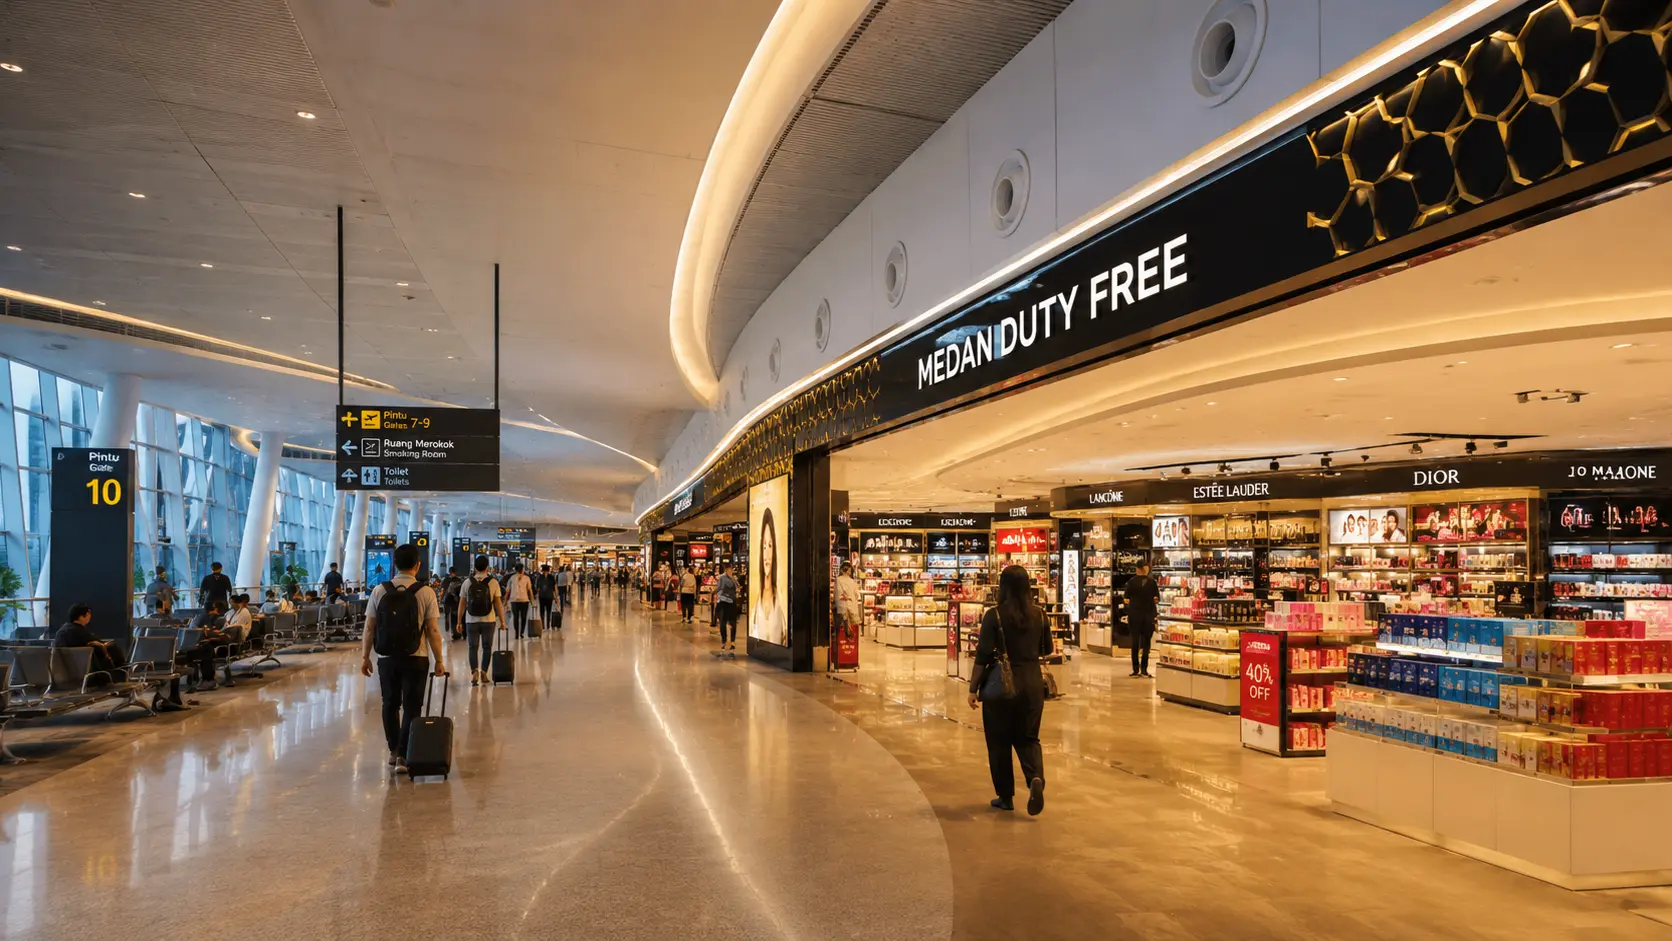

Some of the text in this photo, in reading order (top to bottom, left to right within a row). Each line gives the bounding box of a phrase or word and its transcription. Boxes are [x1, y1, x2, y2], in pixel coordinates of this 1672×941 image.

[918, 233, 1188, 390] MEDAN DUTY FREE
[383, 410, 407, 420] Pintu
[410, 417, 431, 429] 7-9
[383, 438, 455, 450] Ruang Merokok
[88, 451, 120, 462] Pintu
[421, 449, 447, 458] Room
[1413, 469, 1460, 486] DIOR
[86, 478, 121, 505] 10
[1226, 482, 1270, 497] LAUDER
[1249, 685, 1271, 701] OFF
